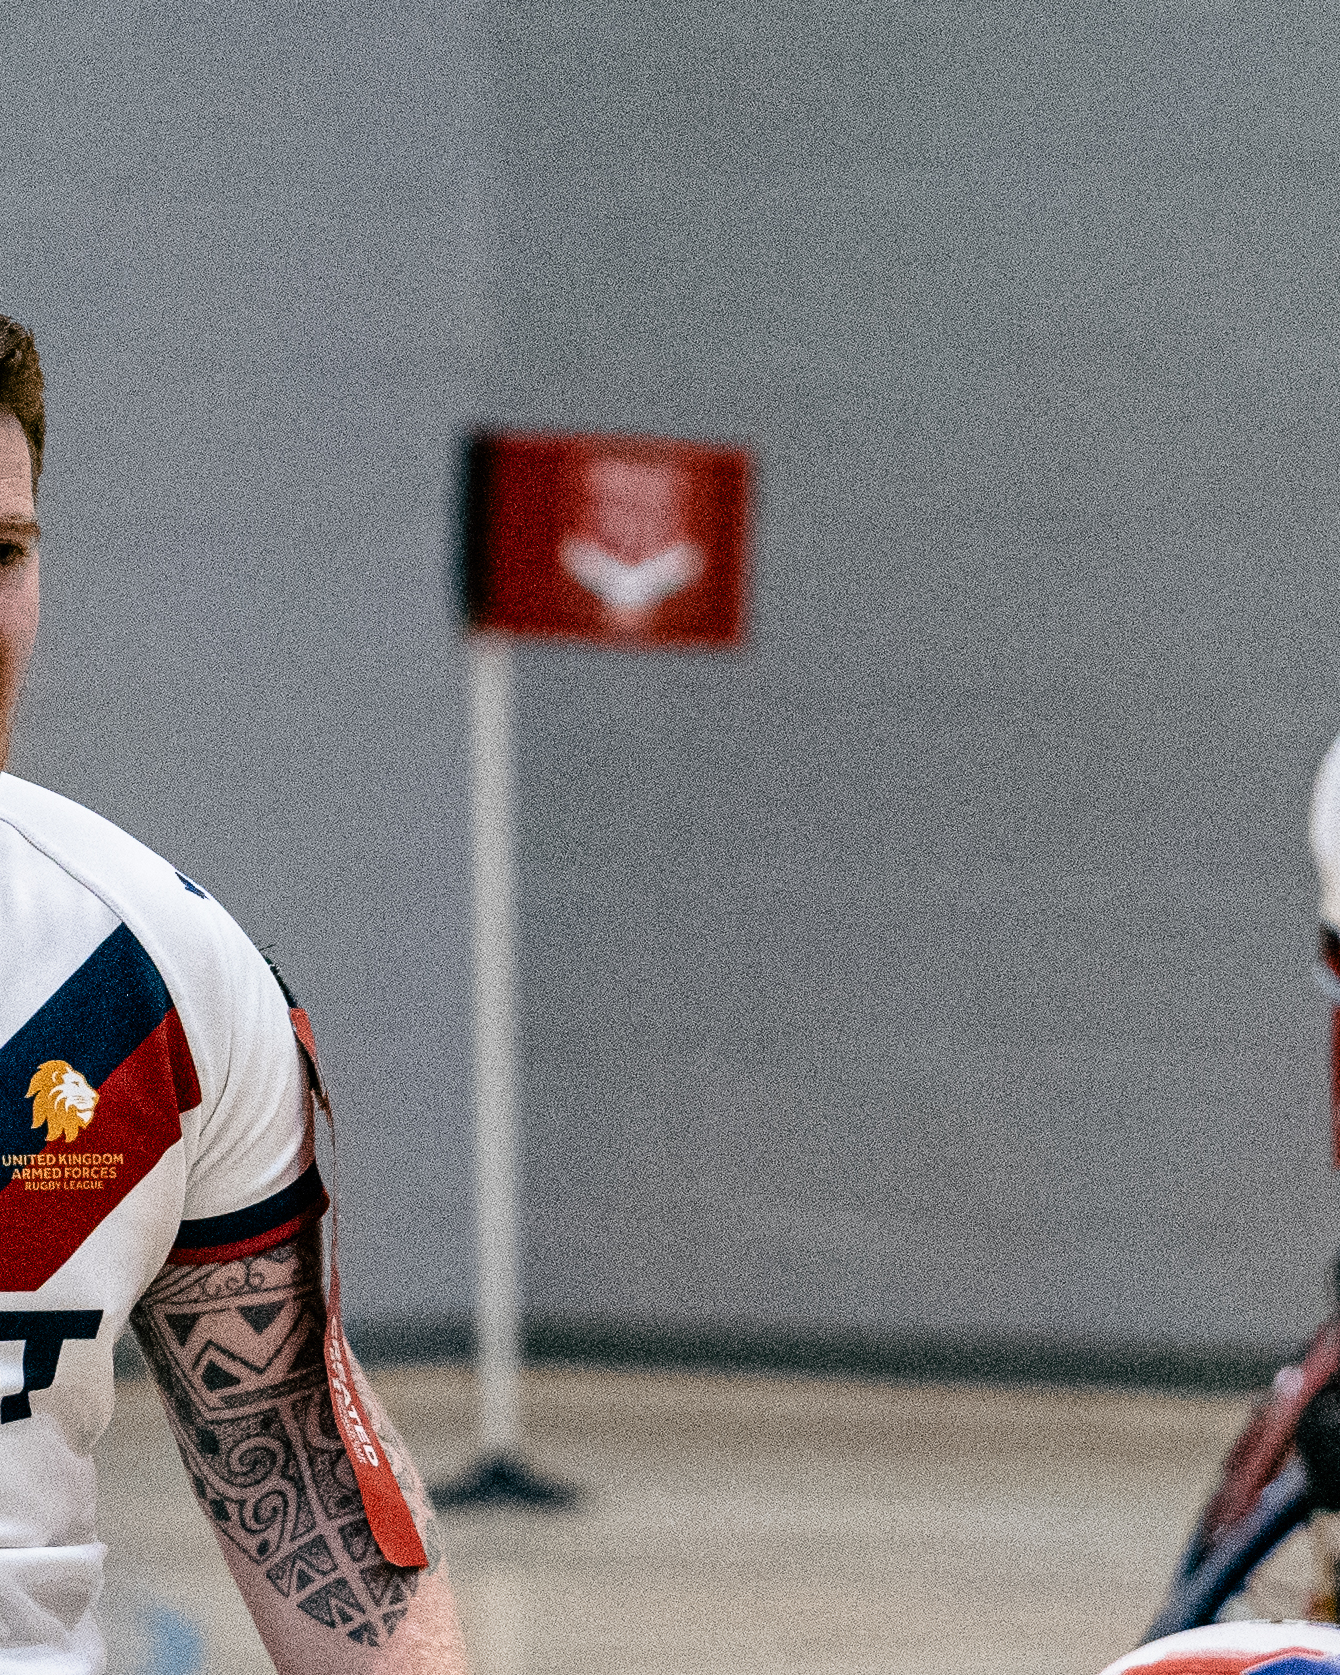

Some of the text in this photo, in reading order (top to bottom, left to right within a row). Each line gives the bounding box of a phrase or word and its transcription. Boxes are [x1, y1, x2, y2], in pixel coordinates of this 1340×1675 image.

[1, 1153, 124, 1166] UNITED KINGDOM
[11, 1166, 117, 1180] ARMED FORCES
[24, 1180, 104, 1191] RUGBY LEAGUE
